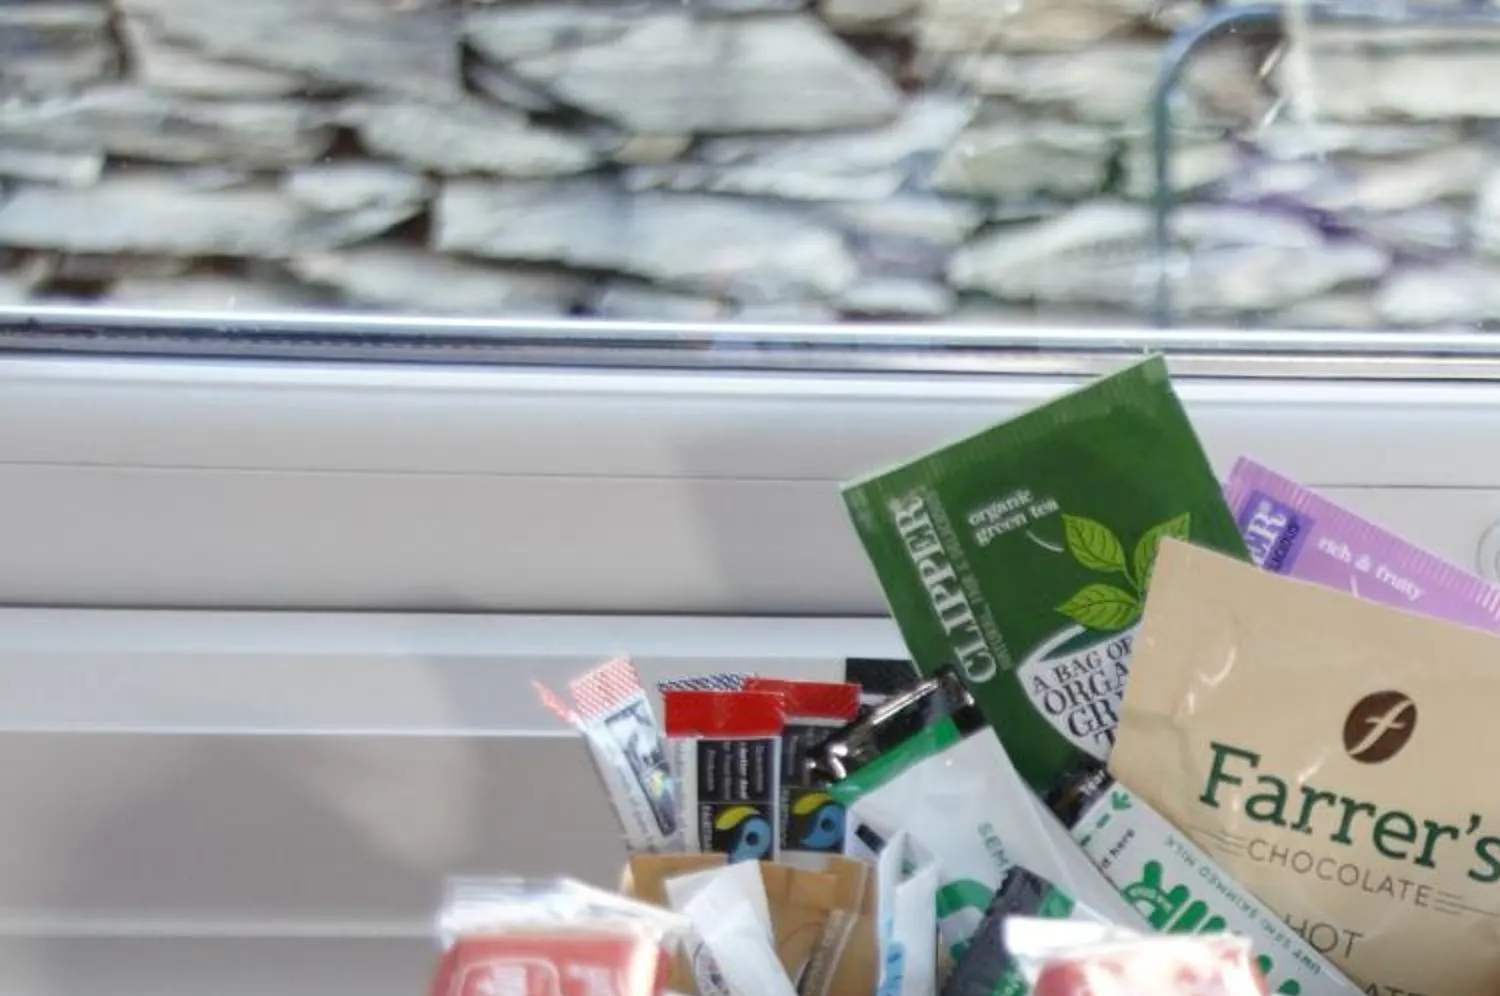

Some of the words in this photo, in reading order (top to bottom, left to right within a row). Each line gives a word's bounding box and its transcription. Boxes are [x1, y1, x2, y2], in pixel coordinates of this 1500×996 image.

[968, 490, 1031, 526] organic
[975, 513, 1029, 547] green
[1029, 499, 1060, 519] tea
[895, 496, 997, 683] CLIPPER
[1317, 537, 1352, 563] rich
[1354, 554, 1372, 572] &
[1375, 565, 1424, 601] fruity
[1033, 675, 1050, 694] A
[1053, 651, 1102, 683] BAG
[978, 822, 1010, 874] SEM
[1109, 828, 1135, 860] here
[1162, 834, 1196, 867] MILK
[1199, 866, 1258, 919] SKIMMED
[1248, 838, 1433, 909] CHOCOLATE
